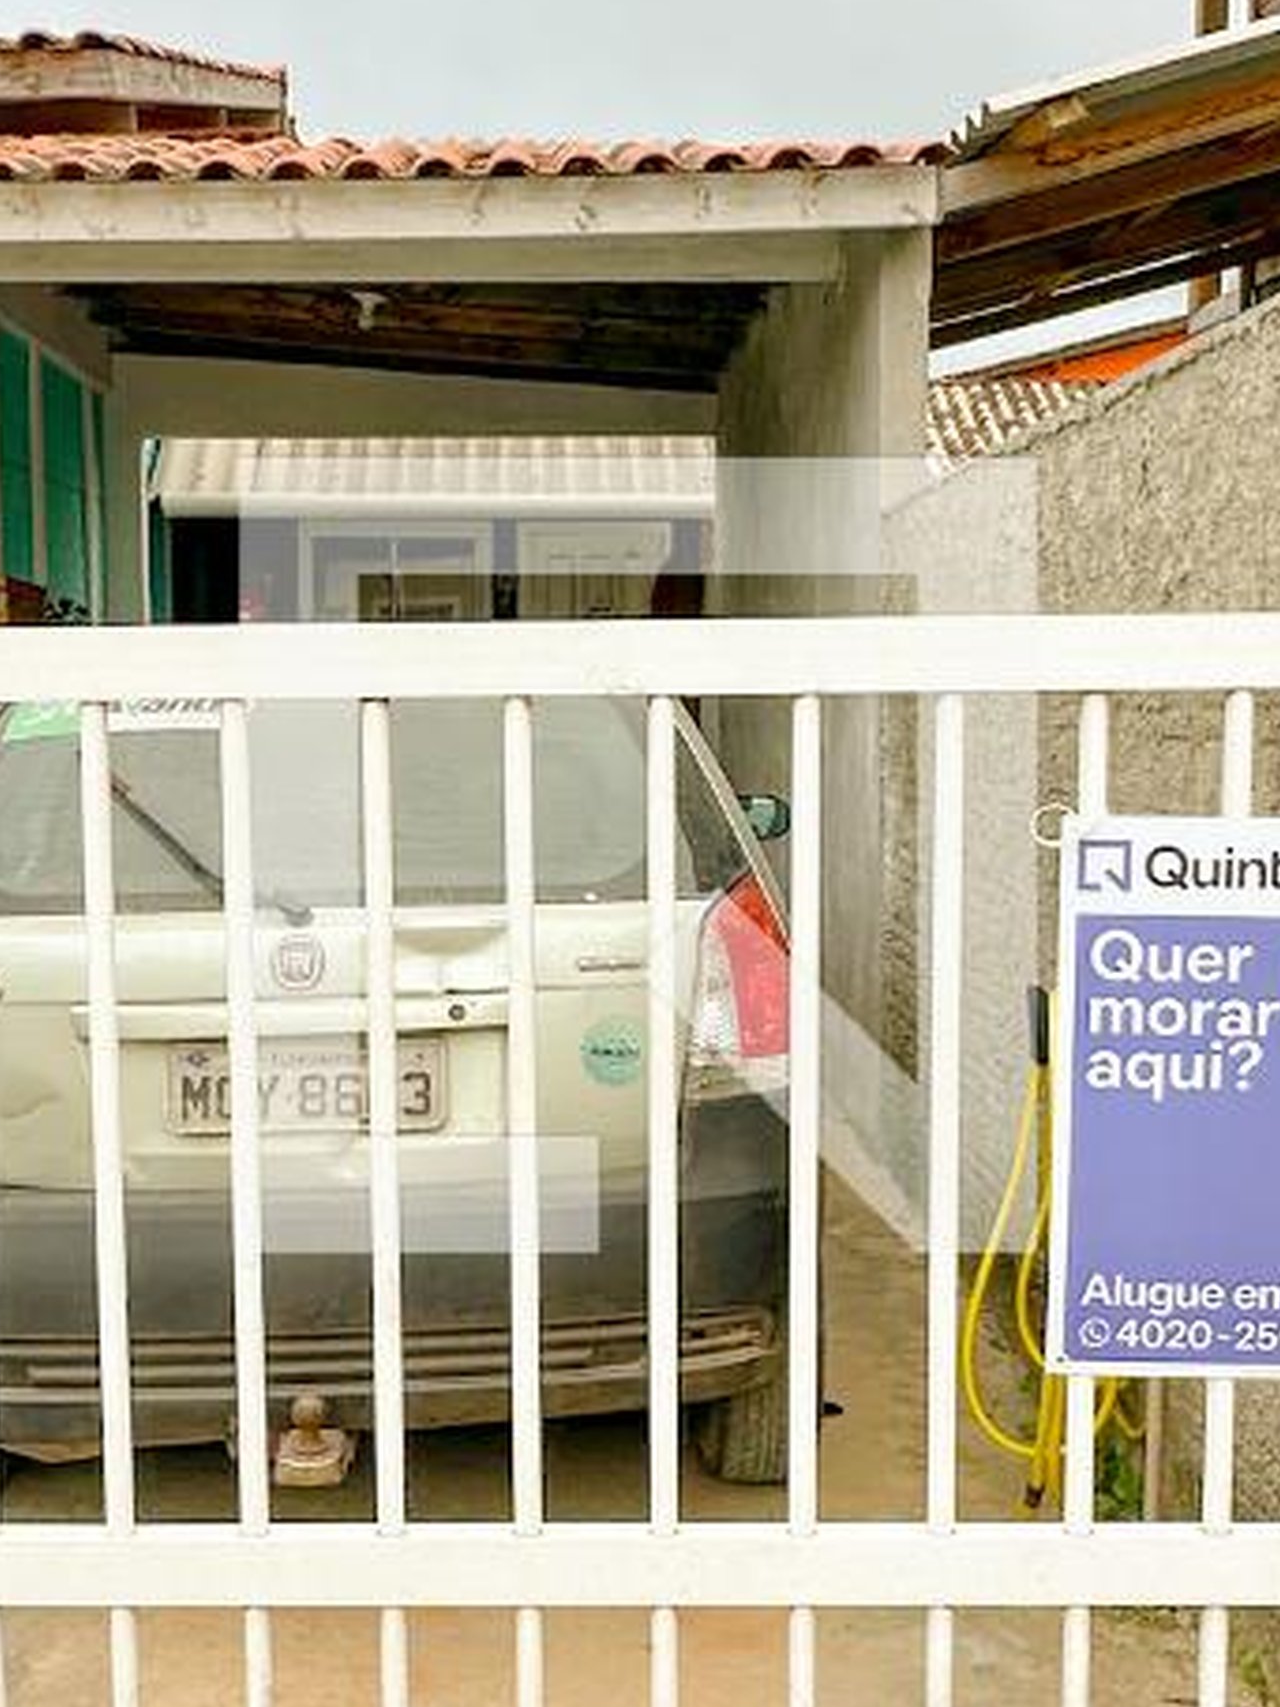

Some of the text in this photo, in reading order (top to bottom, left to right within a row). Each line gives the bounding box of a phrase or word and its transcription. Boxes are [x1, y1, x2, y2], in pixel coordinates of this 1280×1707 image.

[1089, 929, 1254, 984] Quer
[1085, 1040, 1264, 1103] aqui?
[1080, 1273, 1225, 1316] Alugue
